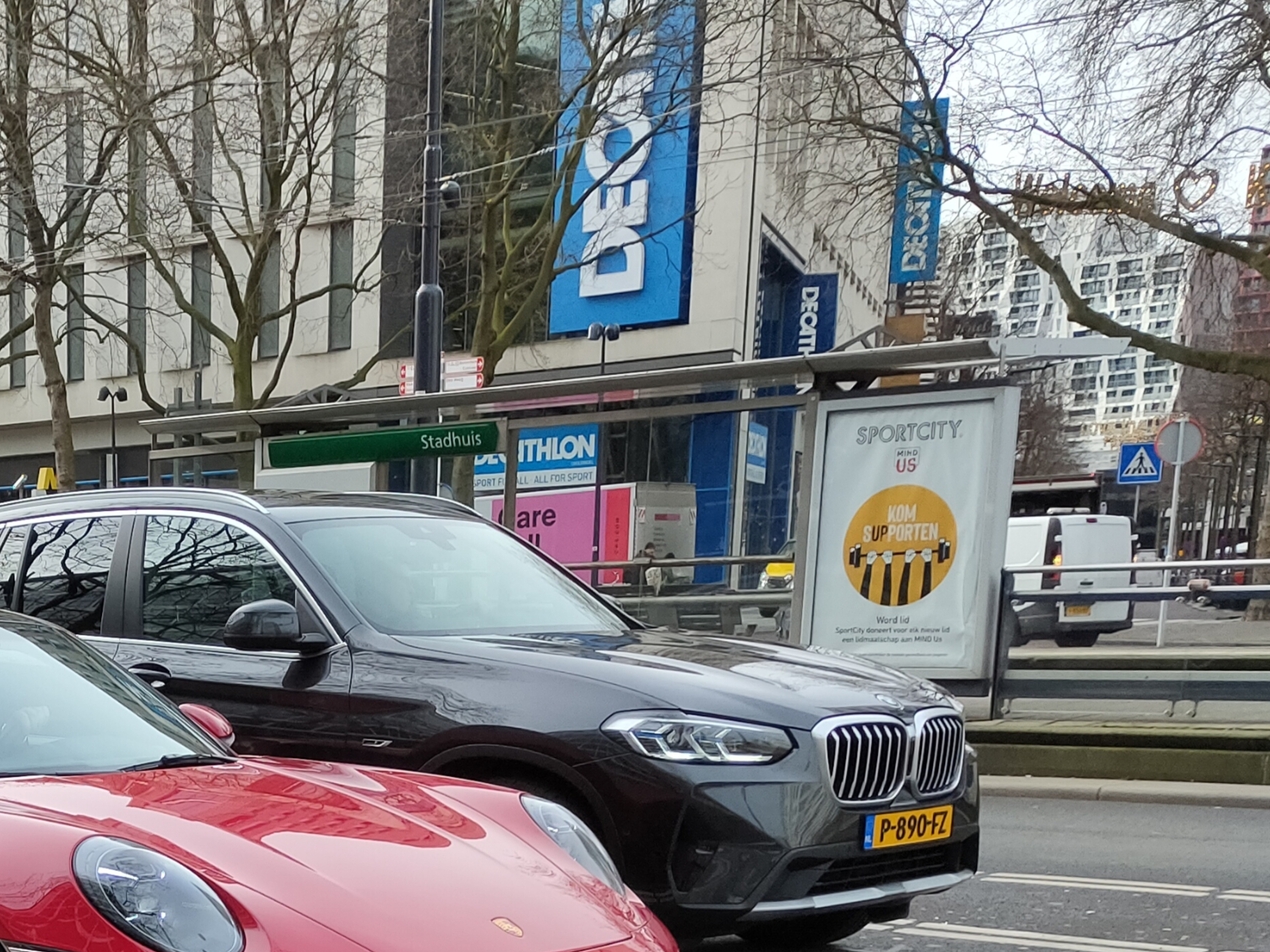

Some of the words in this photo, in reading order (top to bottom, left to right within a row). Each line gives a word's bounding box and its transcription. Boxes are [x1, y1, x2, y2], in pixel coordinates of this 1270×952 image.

[579, 0, 657, 297] DECAT
[420, 430, 482, 450] Stadhuis
[856, 420, 963, 445] SPORTCITY
[896, 449, 919, 457] MIND
[896, 458, 917, 473] US
[534, 474, 549, 484] ALL
[550, 473, 566, 483] FOR
[567, 471, 594, 482] SPORT
[887, 504, 917, 523] KOM
[863, 523, 939, 543] SUPPORTEN
[876, 615, 898, 624] Word
[899, 615, 910, 624] lid
[879, 811, 949, 843] P-890-FZ
